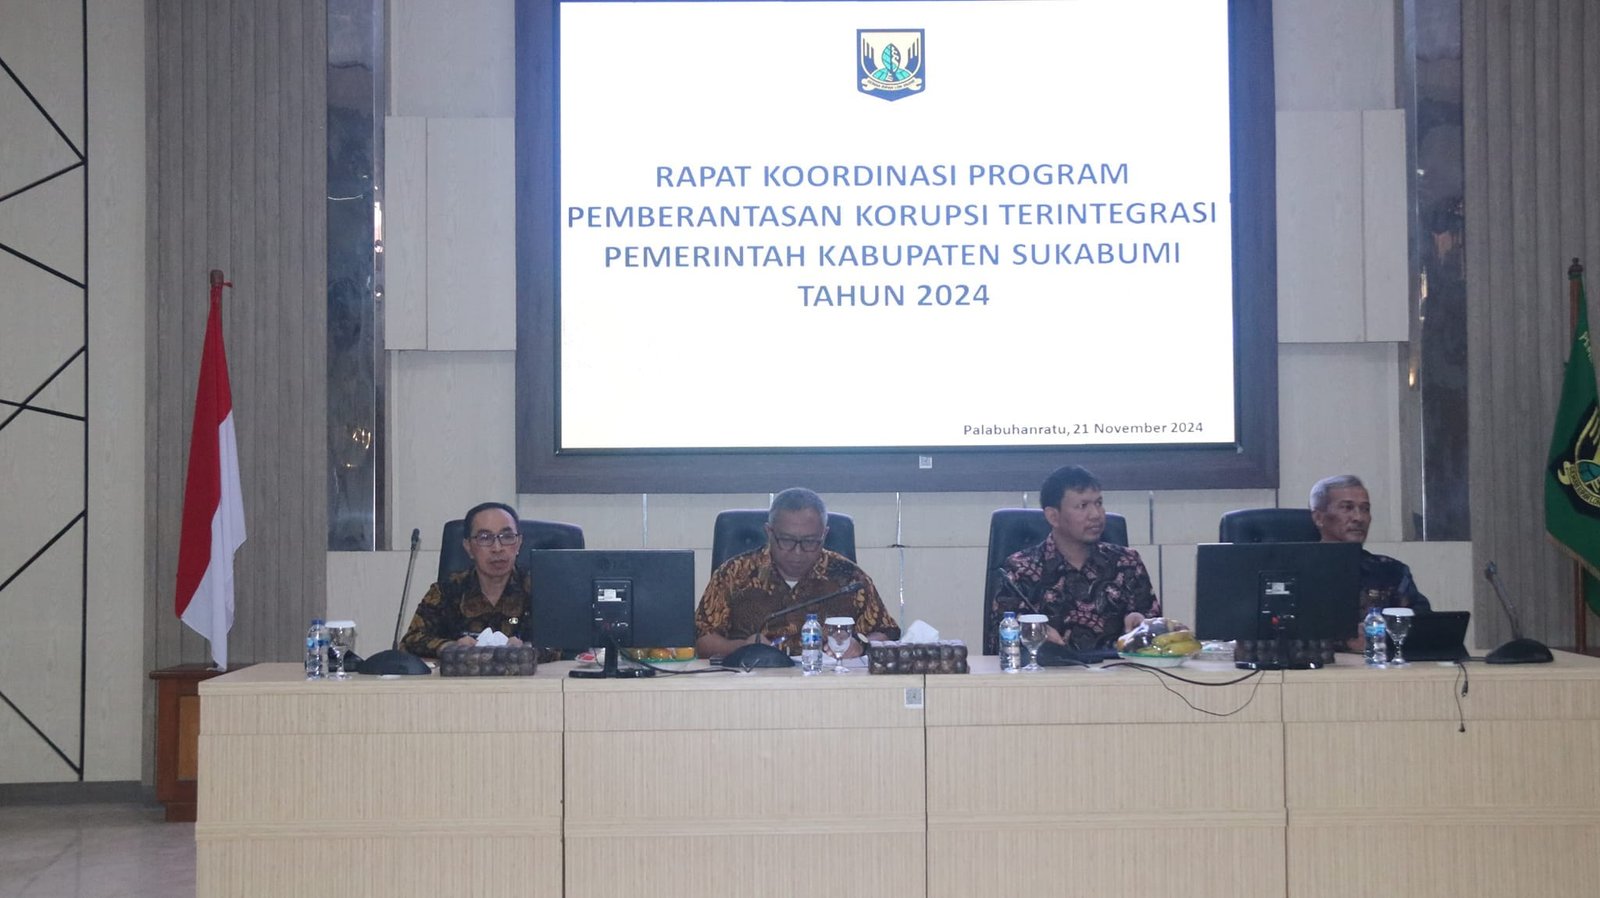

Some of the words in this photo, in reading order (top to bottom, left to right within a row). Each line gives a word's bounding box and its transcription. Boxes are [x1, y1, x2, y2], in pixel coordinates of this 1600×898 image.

[656, 165, 752, 188] RAPAT
[763, 164, 956, 188] KOORDINASI
[969, 163, 1128, 186] PROGRAM
[568, 205, 842, 228] PEMBERANTASAN
[856, 204, 988, 227] KORUPSI
[998, 201, 1217, 226] TERINTEGRASI
[605, 245, 805, 268] PEMERINTAH
[819, 244, 999, 267] KABUPATEN
[1012, 241, 1180, 266] SUKABUMI
[797, 284, 905, 307] TAHUN
[917, 284, 990, 306] 2024
[963, 424, 1071, 437] Palabuhanratu,
[1073, 424, 1089, 434] 21
[1094, 423, 1167, 434] November
[1170, 422, 1203, 433] 2024
